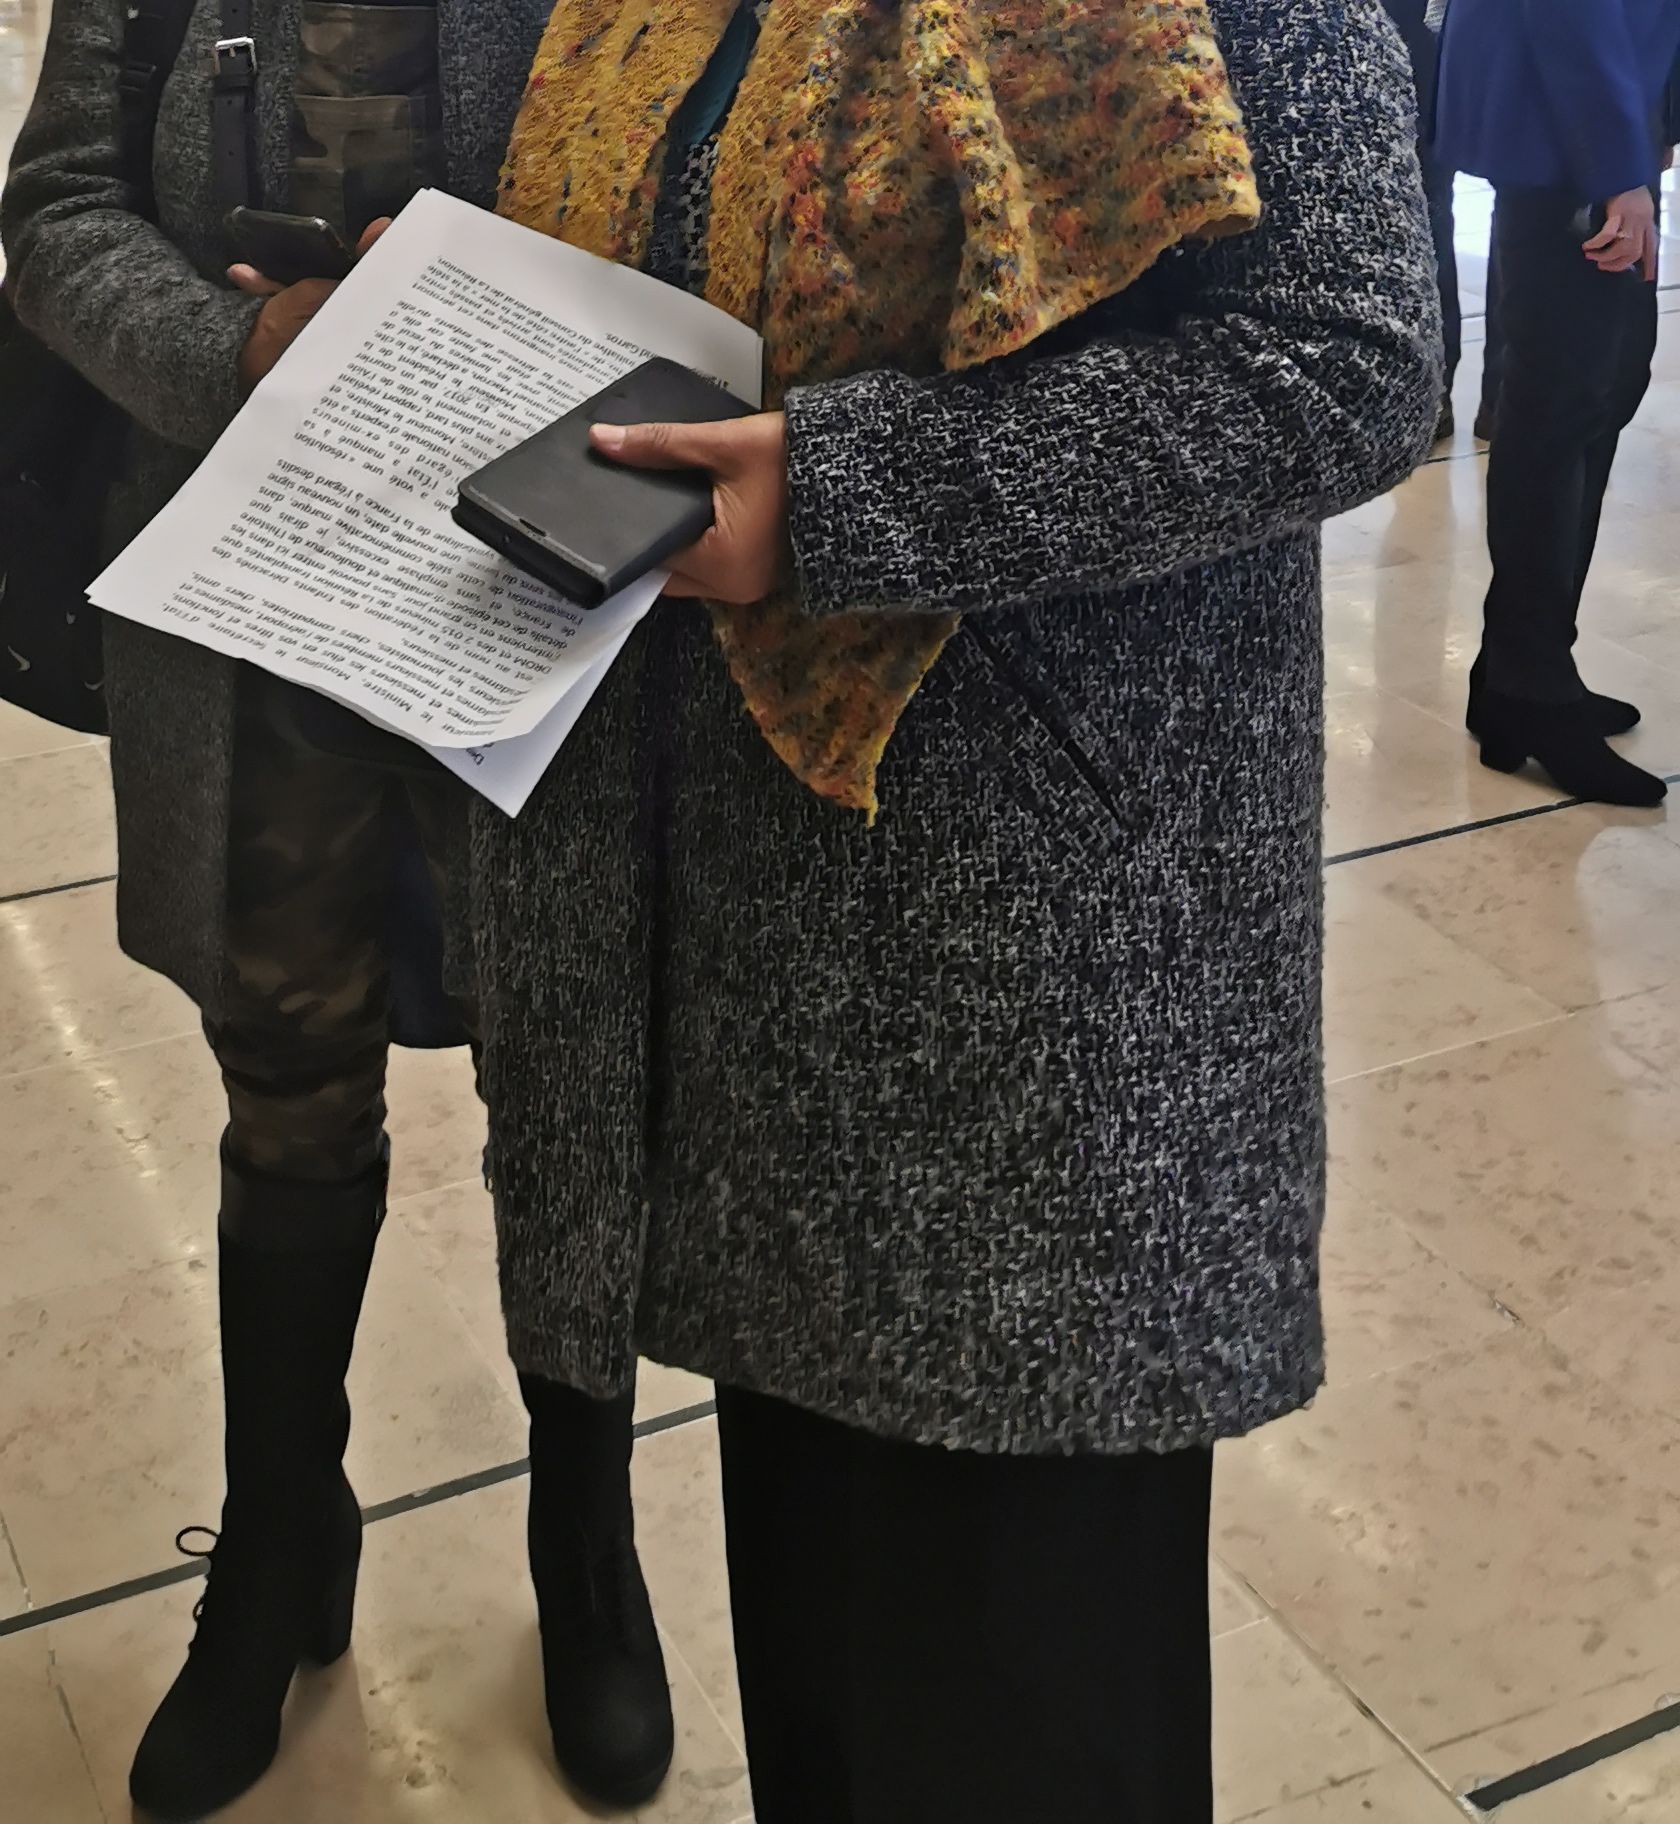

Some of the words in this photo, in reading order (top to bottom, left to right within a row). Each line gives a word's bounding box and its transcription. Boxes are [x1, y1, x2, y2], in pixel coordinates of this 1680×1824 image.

[426, 264, 451, 281] stèle
[419, 273, 447, 291] entre
[411, 281, 456, 307] aéroport
[448, 288, 483, 309] passés
[396, 300, 431, 317] qu'elle
[502, 295, 543, 317] général
[380, 320, 396, 330] de
[401, 315, 422, 327] elle
[433, 317, 472, 338] enfants
[475, 314, 500, 330] dans
[497, 314, 532, 335] arrivés
[524, 318, 549, 334] côté
[539, 315, 577, 338] Conseil
[373, 329, 395, 343] cite,
[396, 327, 426, 342] recul
[531, 333, 556, 349] sont
[362, 340, 374, 351] la
[377, 346, 394, 357] de
[394, 339, 407, 349] le
[406, 344, 420, 354] je
[428, 339, 445, 350] du
[447, 336, 478, 353] faute
[501, 328, 557, 360] inaugurons
[354, 352, 397, 372] courrier
[397, 354, 447, 380] Président
[420, 348, 460, 371] déclaré,
[447, 348, 492, 373] lumières
[496, 348, 539, 372] détresse
[346, 362, 377, 381] l'Aide
[399, 369, 416, 380] un
[460, 366, 469, 374] a
[505, 364, 531, 379] était
[328, 383, 342, 393] et
[337, 372, 381, 395] révélant
[378, 375, 395, 387] de
[418, 378, 439, 389] par
[450, 377, 463, 388] le
[471, 370, 513, 396] Macron,
[396, 383, 419, 397] rôle
[420, 393, 433, 404] le
[442, 386, 472, 405] 2017,
[319, 395, 339, 409] été
[340, 404, 350, 412] a
[346, 389, 391, 416] Ministre,
[381, 391, 422, 413] rapport
[474, 401, 490, 413] En
[350, 408, 400, 434] d'experts
[392, 411, 404, 422] le
[424, 408, 449, 426] tard,
[434, 399, 496, 429] notamment
[302, 418, 316, 429] sa
[311, 407, 380, 441] ex-mineurs
[405, 417, 456, 444] Monsieur
[450, 420, 475, 435] plus
[498, 427, 511, 437] et
[293, 431, 348, 459] résolution
[337, 434, 385, 459] manqué
[387, 439, 410, 455] des
[400, 430, 450, 457] nationale
[276, 458, 315, 480] desdits
[361, 461, 384, 476] une
[391, 458, 401, 467] a
[266, 472, 296, 489] signe
[388, 474, 414, 492] voté
[406, 465, 439, 490] l'État
[258, 485, 285, 503] dans
[313, 475, 354, 498] l'égard
[419, 490, 429, 499] a
[296, 484, 344, 508] nouveau
[354, 491, 364, 502] à
[248, 499, 272, 513] que
[289, 497, 332, 521] marque,
[343, 504, 360, 518] un
[364, 497, 401, 523] France
[239, 511, 287, 539] l'histoire
[278, 511, 309, 530] dirais
[363, 512, 390, 533] date,
[402, 518, 415, 530] la
[229, 523, 247, 537] les
[287, 532, 303, 545] de
[315, 526, 330, 539] je
[415, 524, 431, 536] de
[220, 534, 243, 548] que
[247, 531, 275, 548] dans
[334, 518, 423, 563] commémorative
[390, 529, 438, 553] nouvelle
[211, 545, 232, 559] des
[273, 544, 291, 557] ici
[304, 539, 366, 572] douloureux
[335, 535, 390, 565] excessive,
[438, 549, 462, 562] une
[244, 545, 311, 579] transplantés
[290, 552, 326, 570] entrer
[425, 559, 453, 575] stèle
[235, 556, 289, 584] Déracinés
[327, 568, 371, 588] pouvoir
[365, 567, 380, 578] et
[396, 564, 448, 589] emphase
[178, 582, 193, 591] et
[191, 571, 221, 588] amis,
[312, 574, 359, 598] Réunion
[455, 571, 485, 587] cette
[224, 585, 255, 601] chers
[293, 579, 335, 602] Enfants
[371, 584, 398, 599] Sans
[380, 573, 445, 603] dramatique
[455, 587, 481, 602] sans
[172, 592, 225, 619] fonctions,
[193, 587, 253, 614] mesdames
[339, 598, 360, 610] des
[375, 598, 392, 608] de
[261, 598, 335, 631] compatriotes,
[394, 605, 440, 628] mineurs
[426, 605, 463, 623] grand
[445, 599, 491, 622] épisode
[225, 615, 241, 624] et
[363, 606, 424, 636] Fédération
[207, 621, 266, 650] Secrétaire
[243, 621, 274, 638] titres
[312, 633, 330, 643] de
[339, 628, 371, 644] chers
[277, 634, 298, 646] vos
[300, 642, 318, 652] en
[443, 640, 460, 651] de
[476, 640, 497, 653] des
[528, 629, 568, 649] détails
[320, 649, 346, 662] élus
[329, 639, 384, 663] membres
[377, 641, 444, 676] journalistes,
[401, 637, 457, 668] messieurs,
[463, 648, 491, 664] nom
[497, 648, 512, 659] et
[295, 655, 351, 680] Monsieur
[384, 660, 441, 690] messieurs
[456, 664, 472, 674] et
[493, 662, 511, 673] au
[369, 668, 426, 699] messieurs
[447, 674, 464, 688] les
[361, 678, 412, 712] Ministre,
[439, 687, 455, 697] et
[427, 697, 443, 708] et
